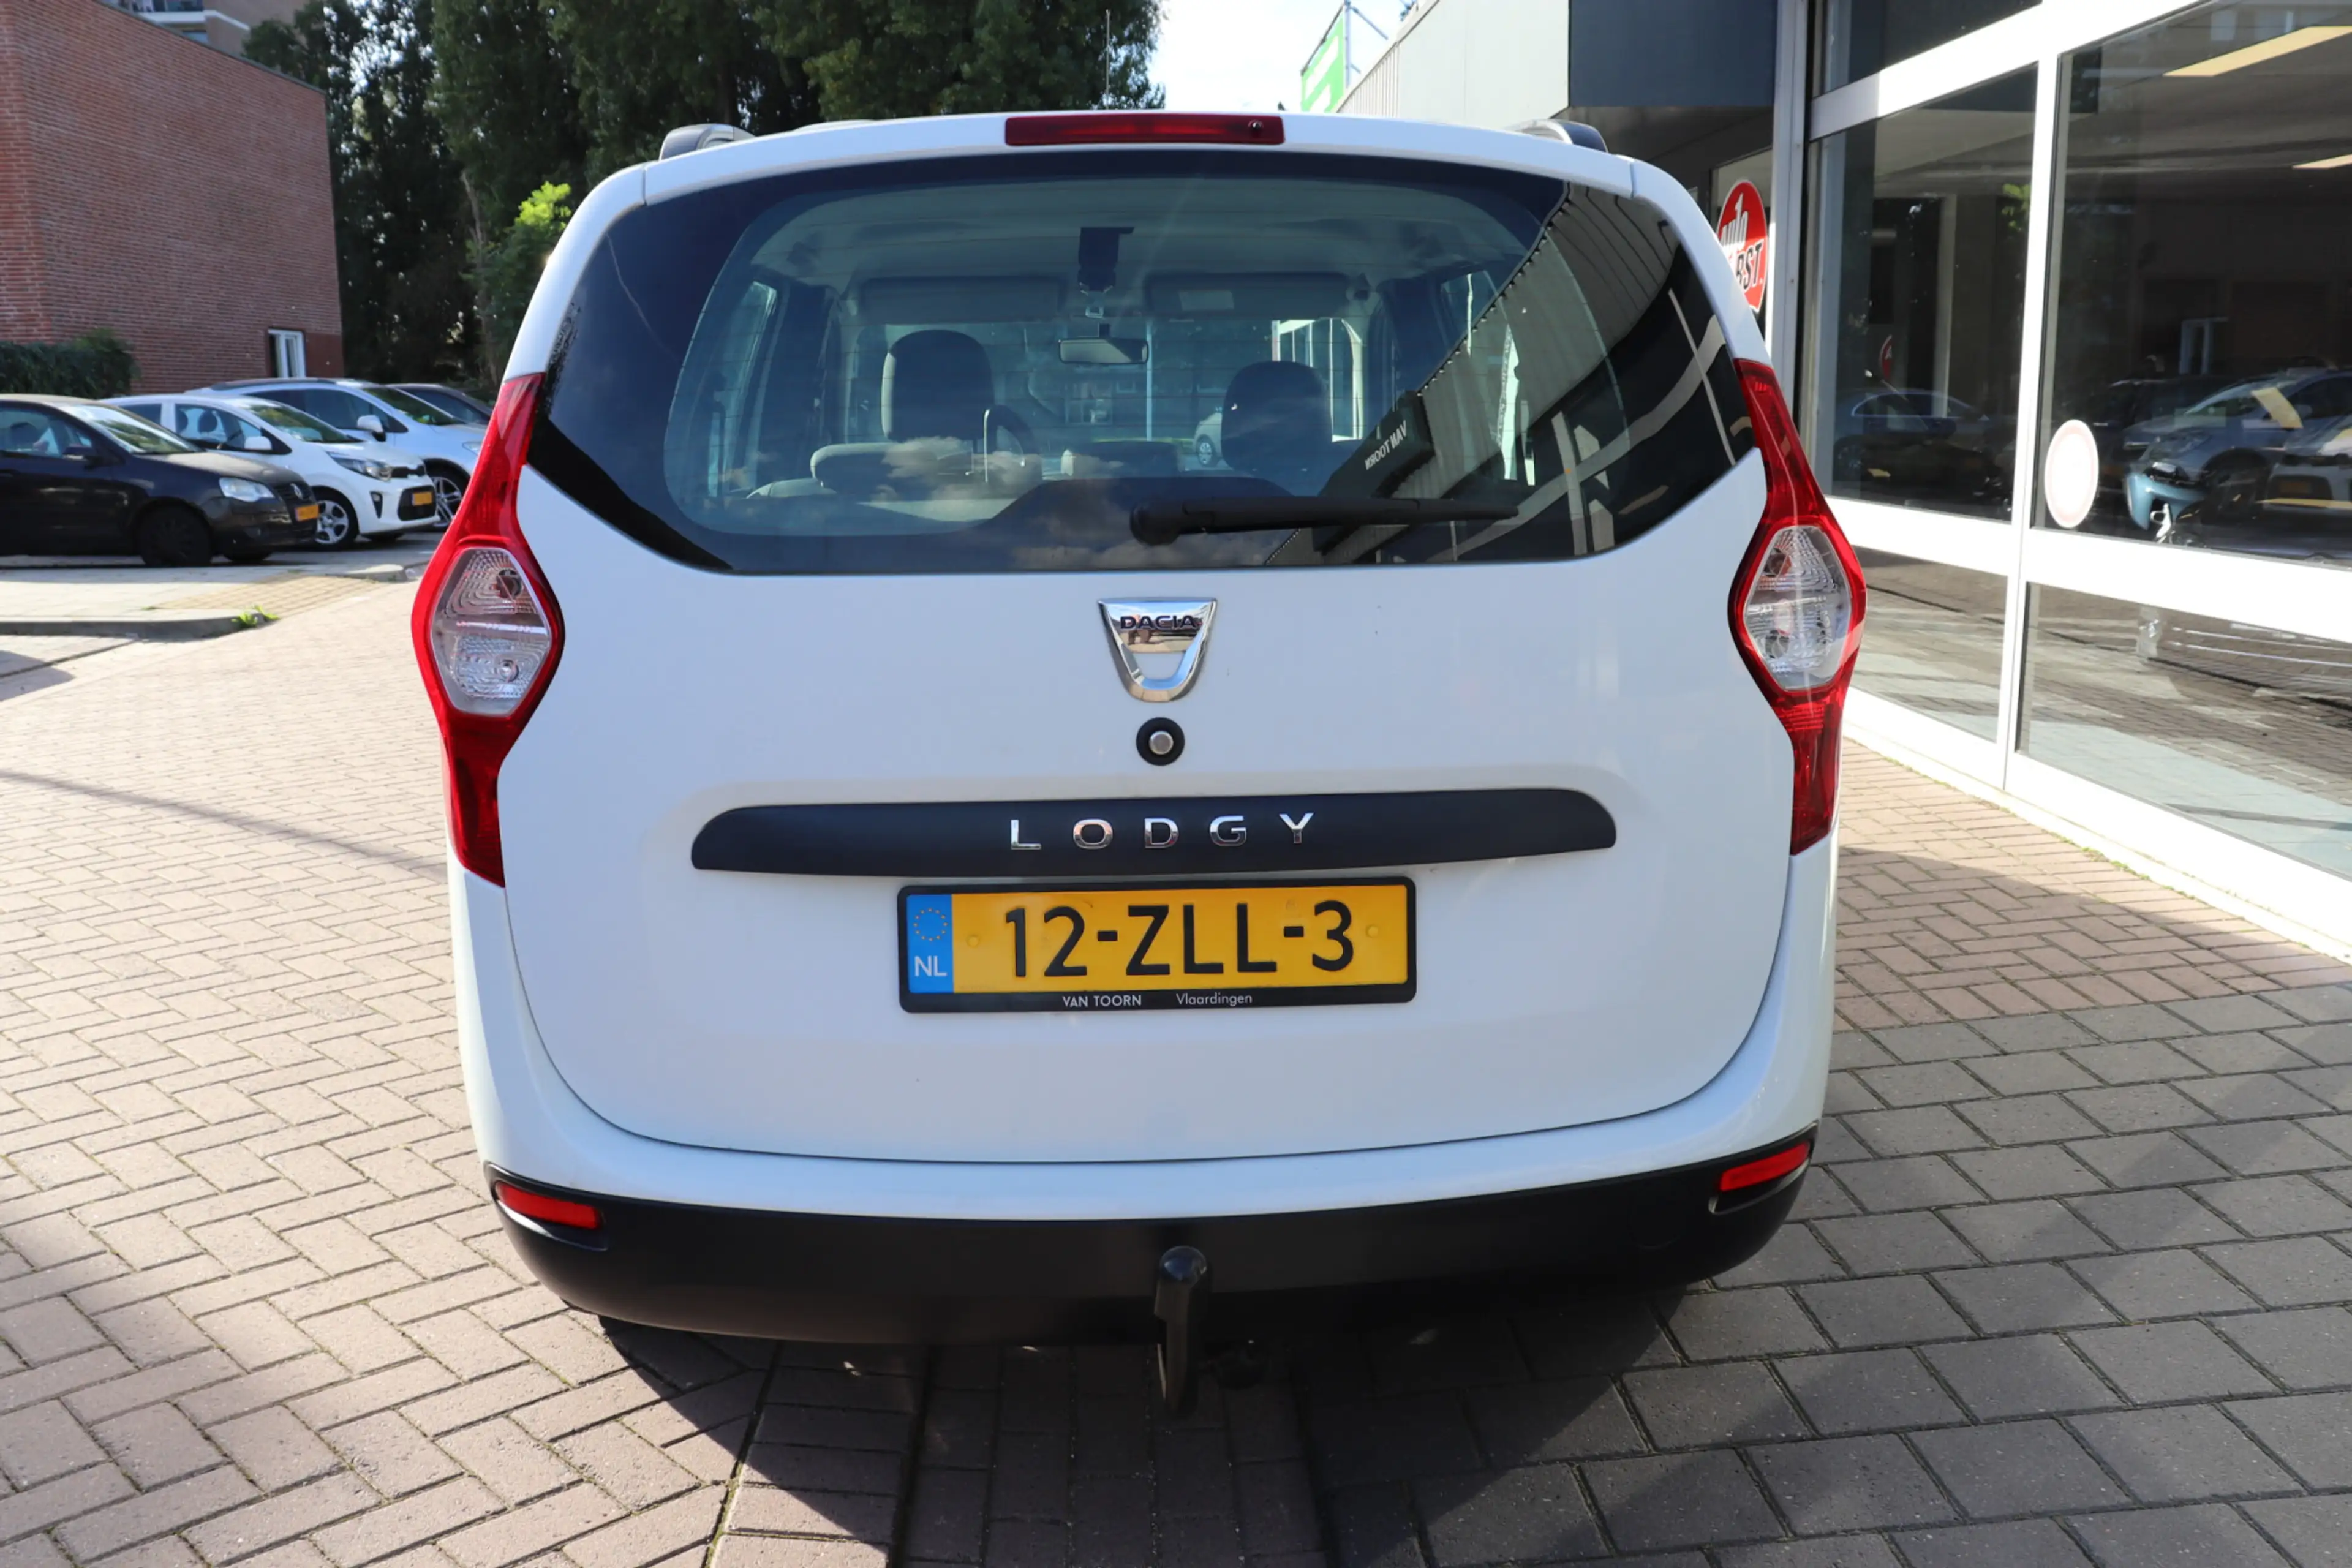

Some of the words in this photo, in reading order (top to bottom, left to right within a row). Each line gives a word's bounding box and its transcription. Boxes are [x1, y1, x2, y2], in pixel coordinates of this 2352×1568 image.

[1736, 239, 1765, 290] RST
[1120, 615, 1197, 630] DACIA
[1011, 812, 1314, 850] LODGY
[1005, 899, 1354, 978] 12-ZLL-3
[914, 956, 948, 977] NL
[1062, 995, 1088, 1008] VAN
[1093, 994, 1142, 1006] TOORN
[1175, 992, 1253, 1006] Vlaardingen
